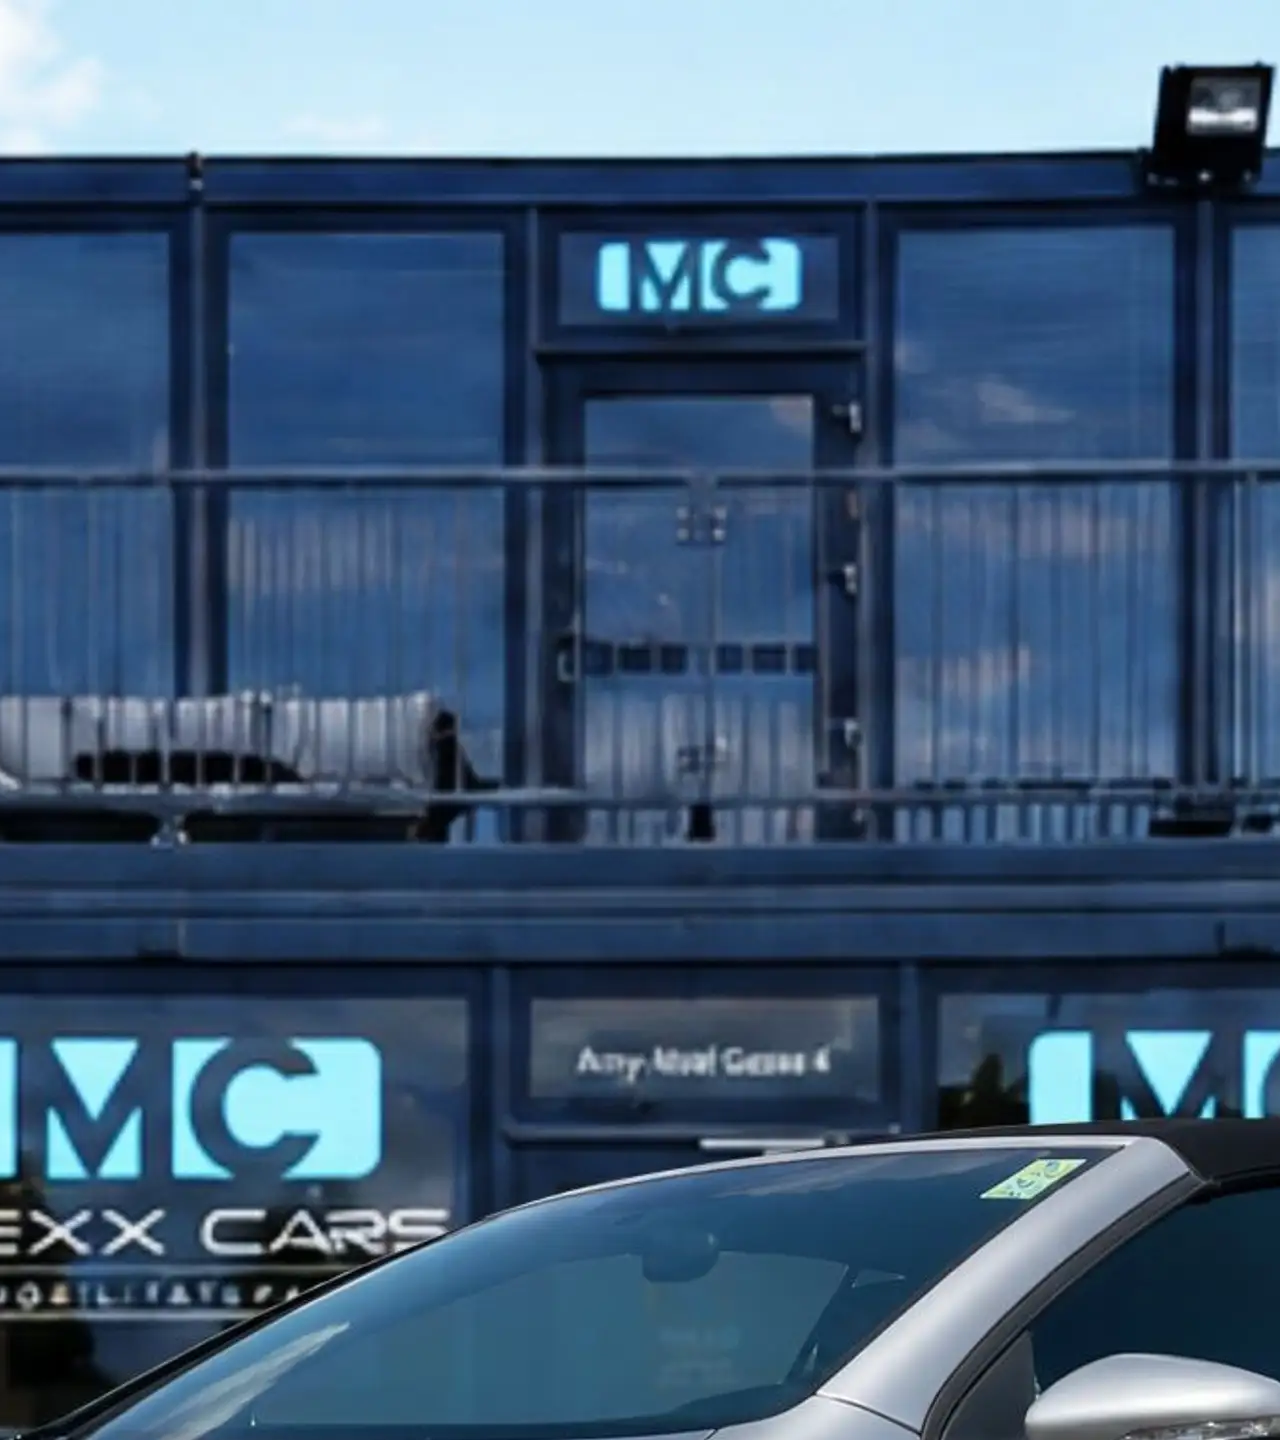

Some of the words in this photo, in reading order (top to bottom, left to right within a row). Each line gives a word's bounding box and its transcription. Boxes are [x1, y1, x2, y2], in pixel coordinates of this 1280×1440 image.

[620, 238, 776, 311] MC
[5, 1036, 328, 1180] MC
[200, 1208, 449, 1256] CARS
